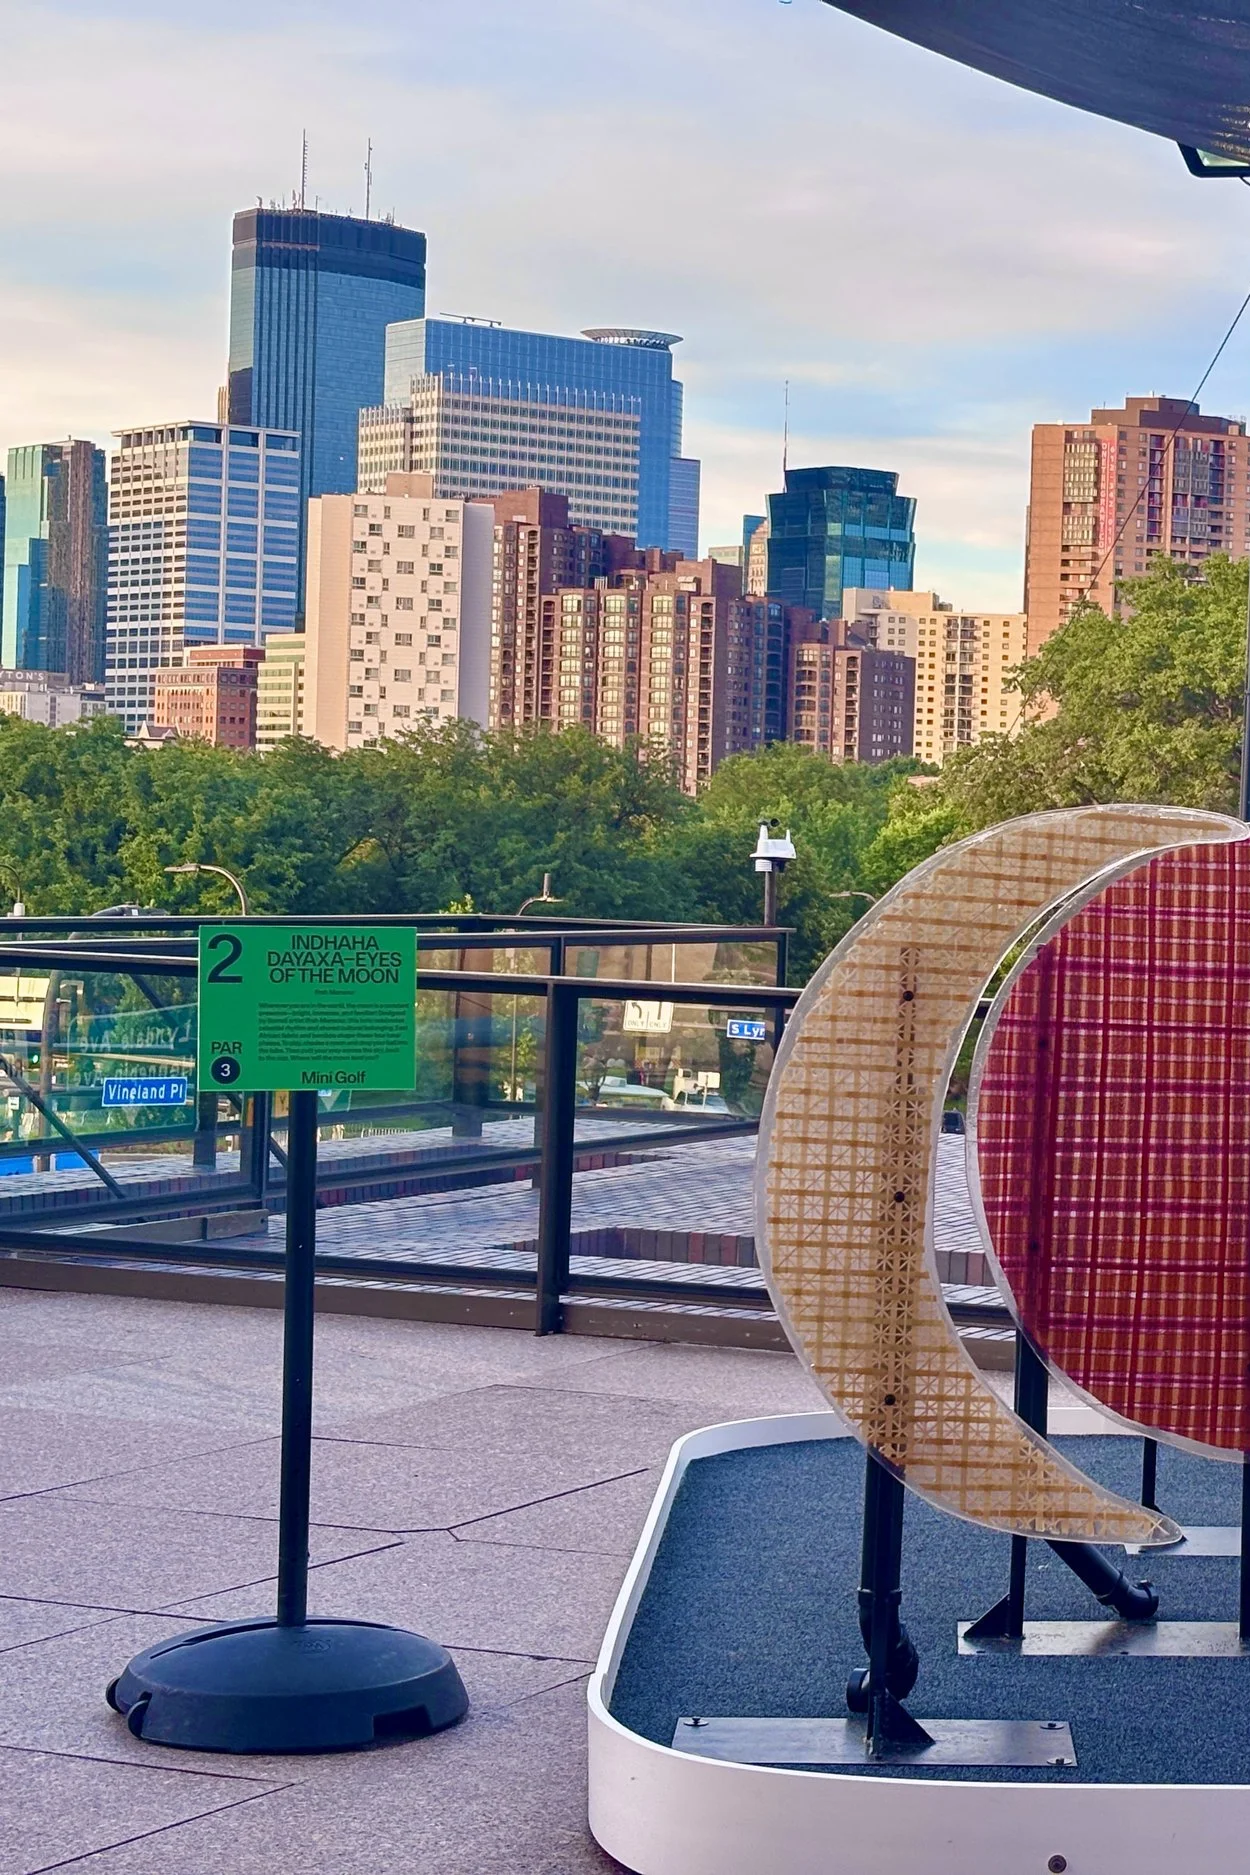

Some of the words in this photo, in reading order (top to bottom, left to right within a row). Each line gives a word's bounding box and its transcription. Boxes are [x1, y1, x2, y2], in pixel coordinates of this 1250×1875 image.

[291, 935, 379, 950] INDHAHA
[207, 933, 243, 984] 2
[269, 968, 296, 984] OF
[298, 968, 334, 984] THE
[338, 968, 399, 984] MOON
[731, 1024, 740, 1034] S
[211, 1041, 242, 1054] PAR
[220, 1063, 231, 1077] 3
[302, 1071, 333, 1084] Mini
[335, 1071, 366, 1084] Golf
[108, 1084, 165, 1100] Vineland
[170, 1083, 183, 1099] Pl
